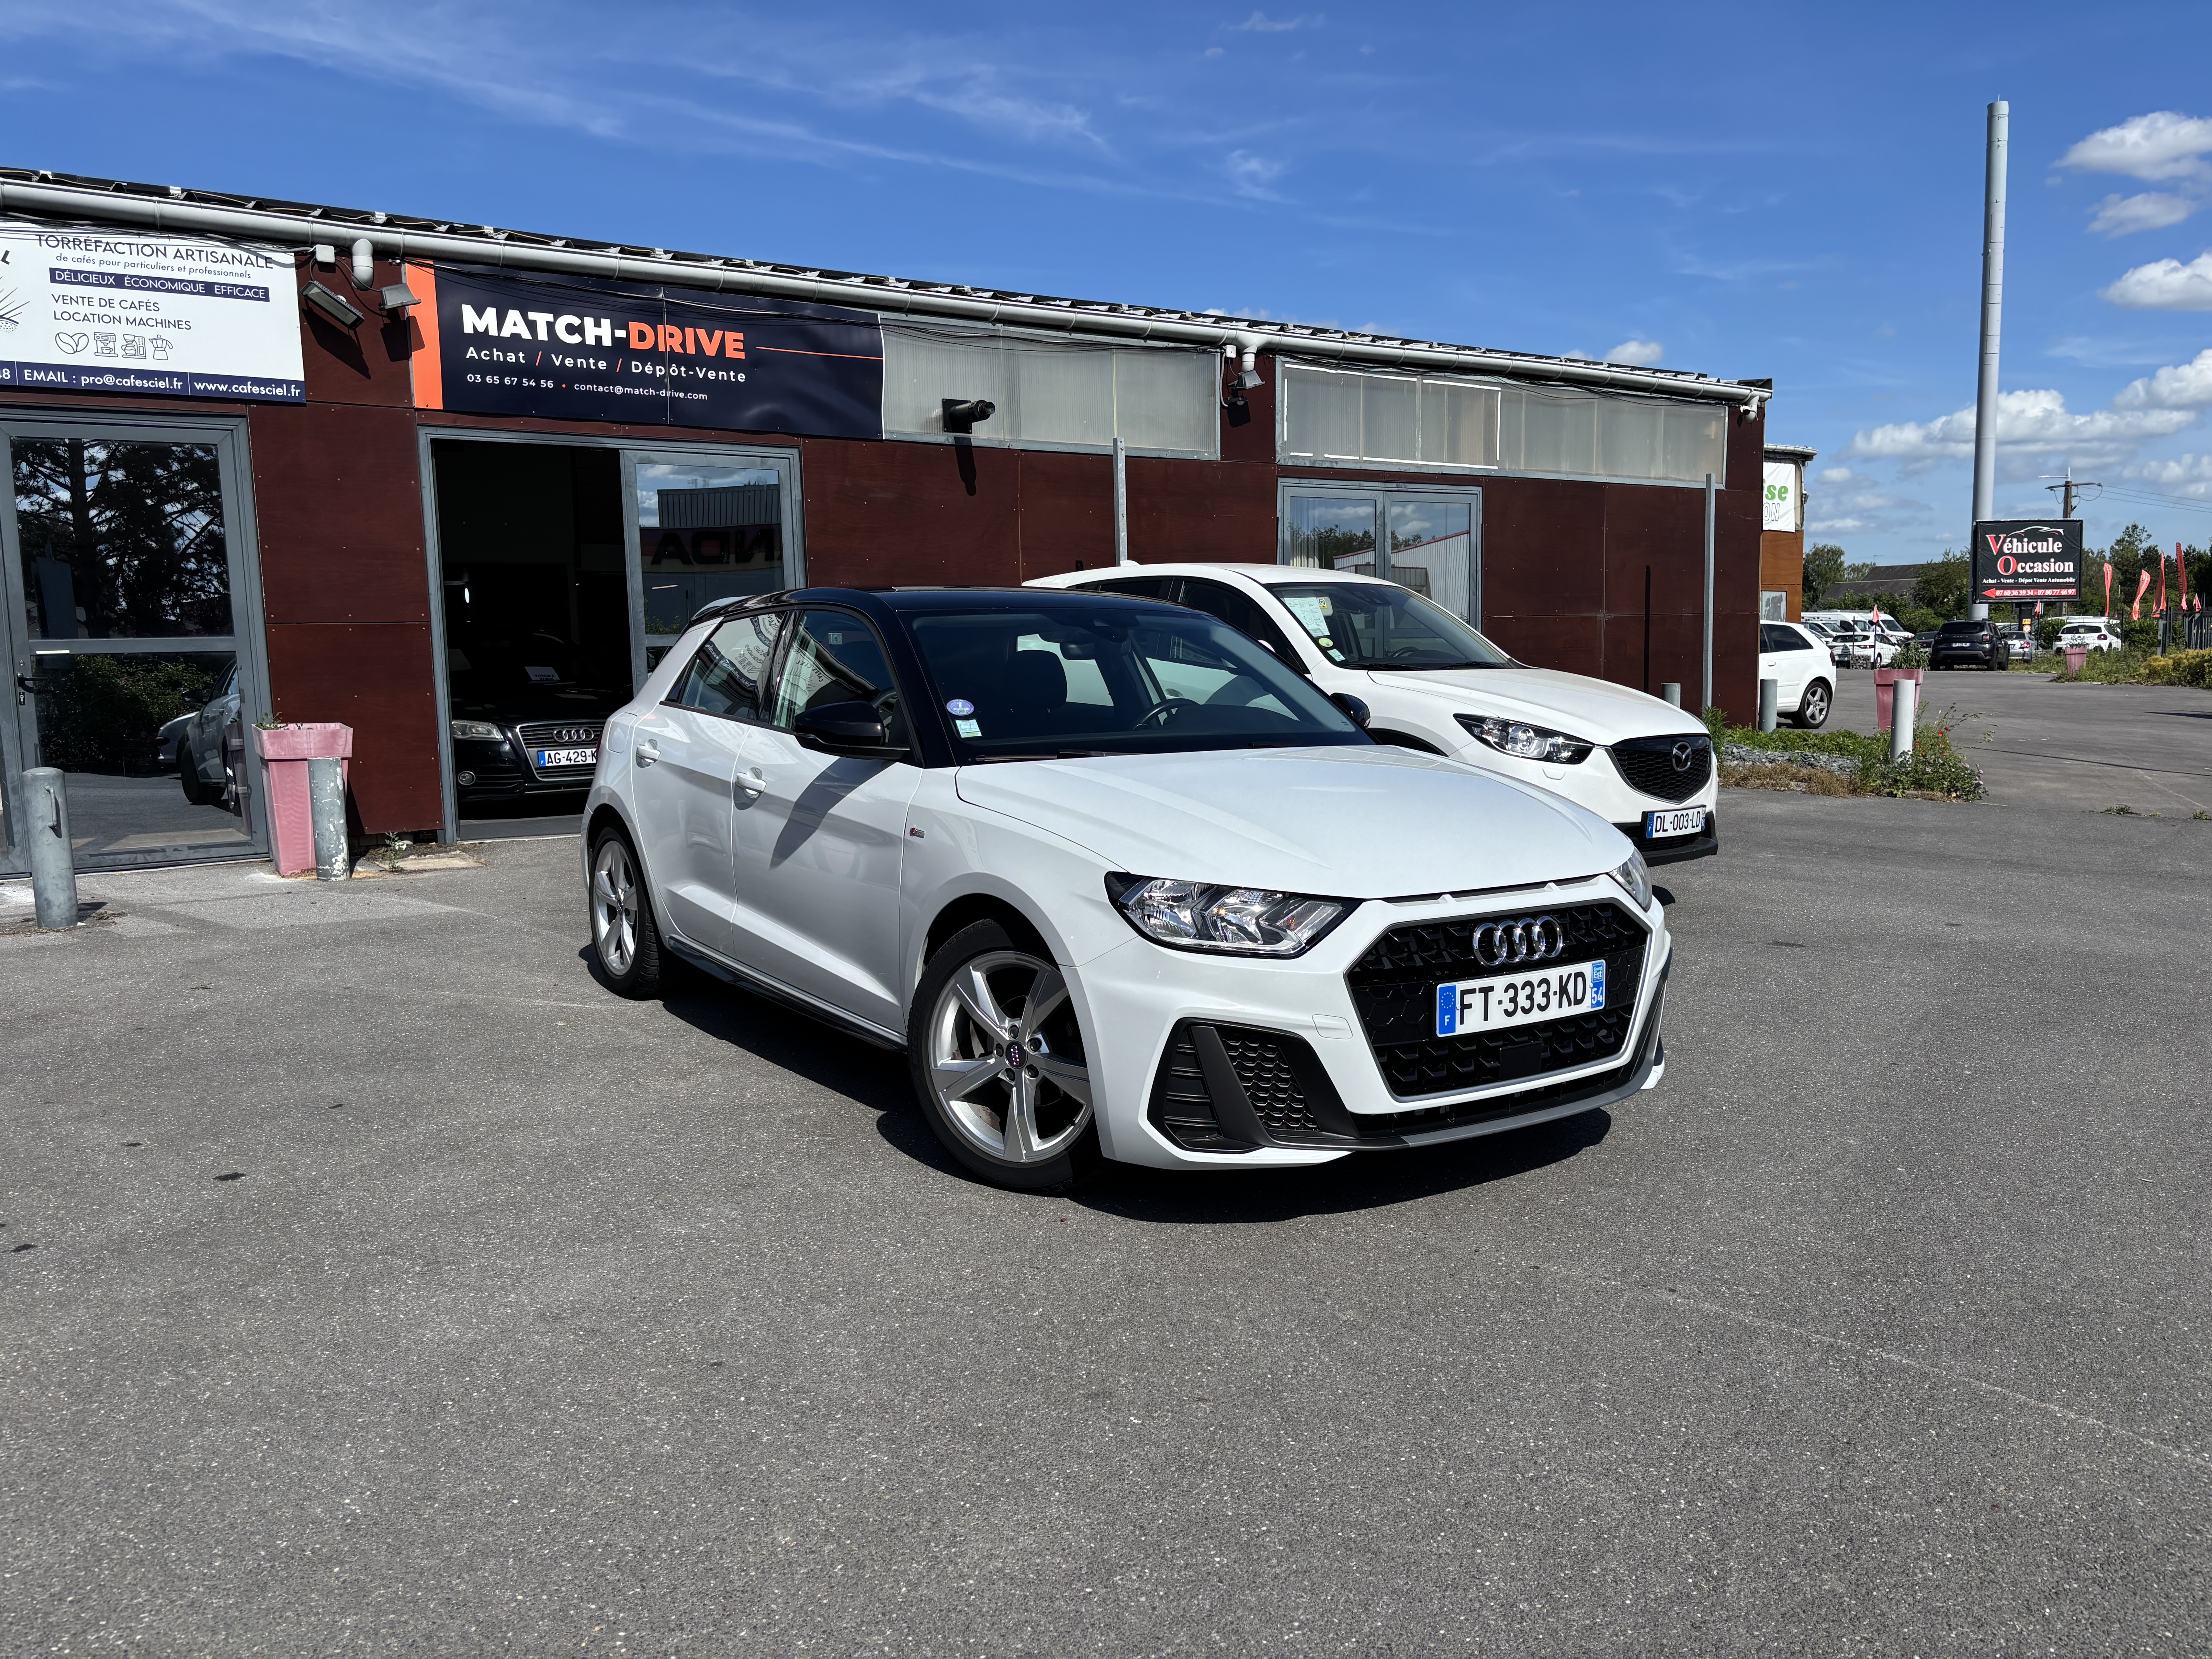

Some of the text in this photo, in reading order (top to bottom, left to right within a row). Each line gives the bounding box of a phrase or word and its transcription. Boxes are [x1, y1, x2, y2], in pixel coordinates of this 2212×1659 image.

[36, 235, 273, 269] TORRÉFACTION ARTISANALE
[56, 253, 68, 262] de
[72, 255, 96, 264] cafés
[124, 261, 174, 271] particuliers
[189, 266, 251, 278] professionnels
[55, 270, 266, 298] DÉLICIEUX ÉCONOMIQUE EFFICACE
[52, 294, 160, 312] VENTE DE CAFÉS
[54, 310, 191, 330] LOCATION MACHINES
[462, 304, 745, 359] MATCH-DRIVE
[466, 347, 526, 363] Achat
[551, 354, 607, 370] Vente
[632, 361, 745, 382] Dépôt-Vente
[0, 368, 11, 380] 8
[24, 369, 69, 383] EMAIL
[81, 374, 183, 389] pro@cafesciel.fr
[194, 381, 301, 397] www.cafesciel.fr
[467, 374, 708, 400] 03 65 67 54 56 contact@match-drive.com
[1763, 478, 1789, 501] se
[1985, 534, 2063, 555] Véhicule
[1997, 555, 2074, 575] Occasion
[1593, 970, 1602, 979] Est
[1459, 971, 1587, 1025] FT-333-KD
[1592, 986, 1603, 1004] 54
[1445, 1015, 1450, 1026] F
